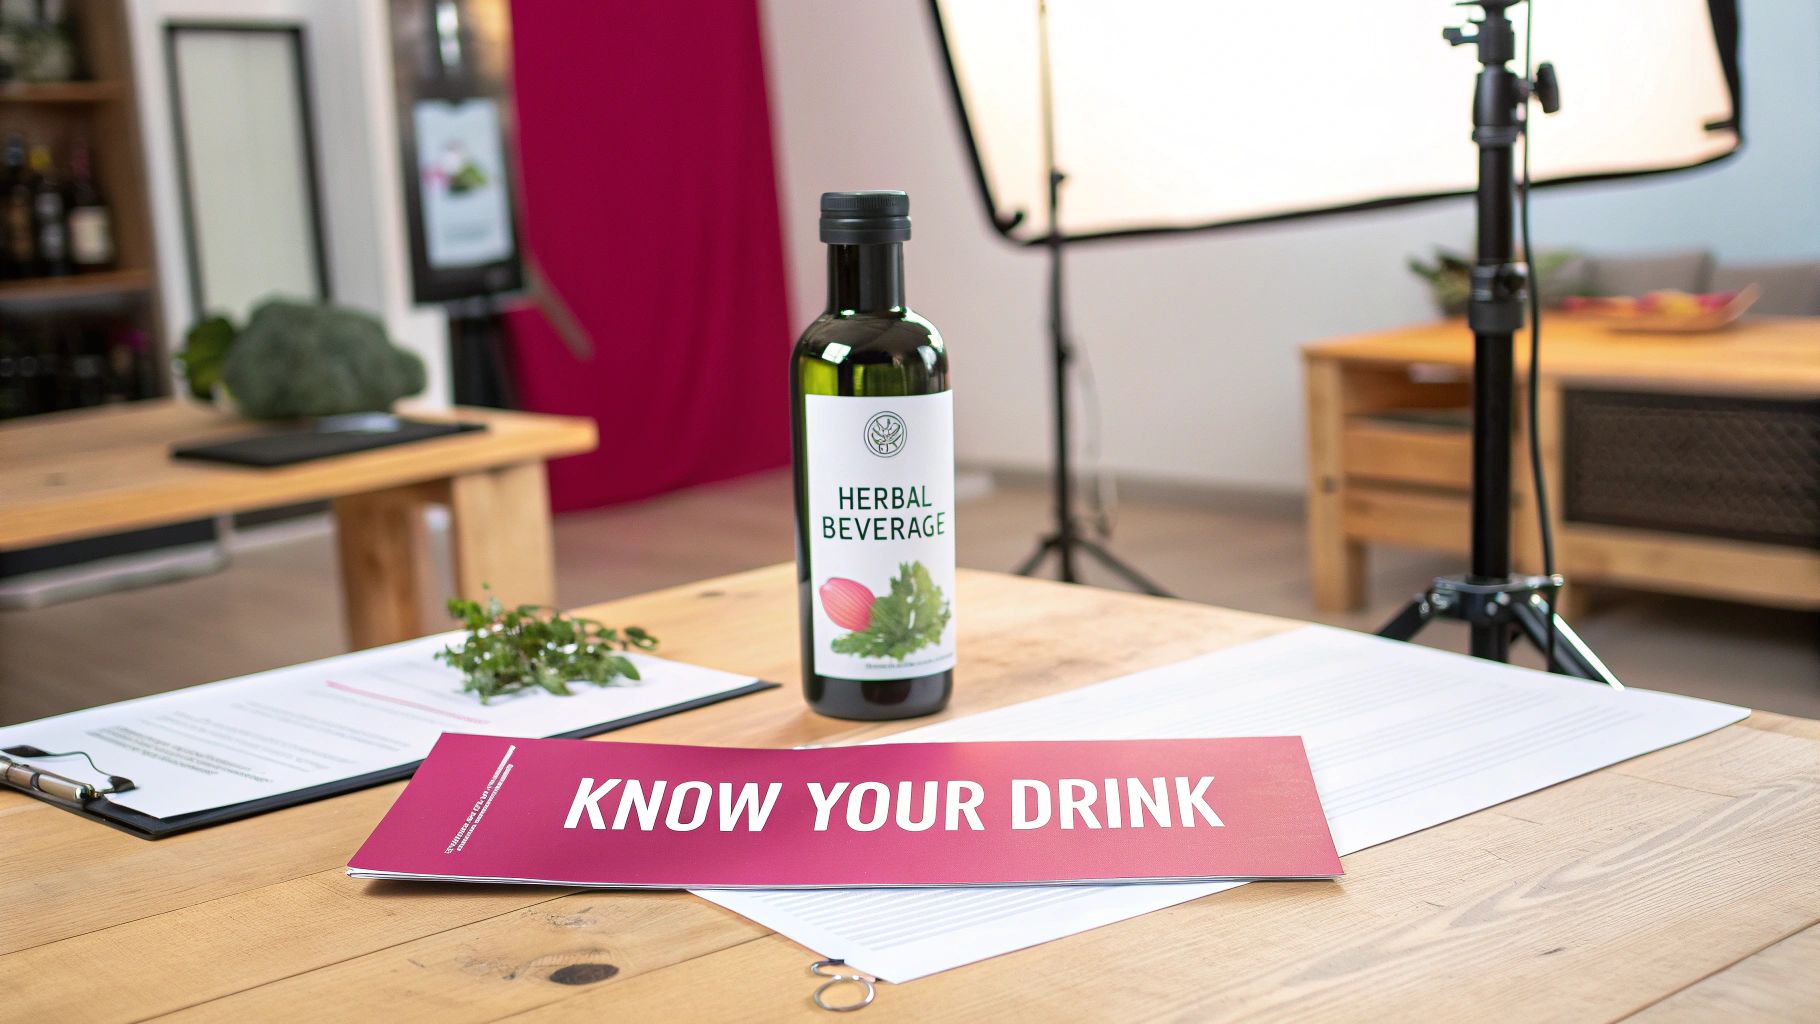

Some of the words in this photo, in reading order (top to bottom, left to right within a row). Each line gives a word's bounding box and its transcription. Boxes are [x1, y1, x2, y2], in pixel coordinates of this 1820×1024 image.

[838, 485, 932, 510] HERBAL
[822, 512, 946, 541] BEVERAGE
[563, 777, 783, 832] KNOW
[806, 780, 985, 832] YOUR
[1010, 776, 1225, 830] DRINK
